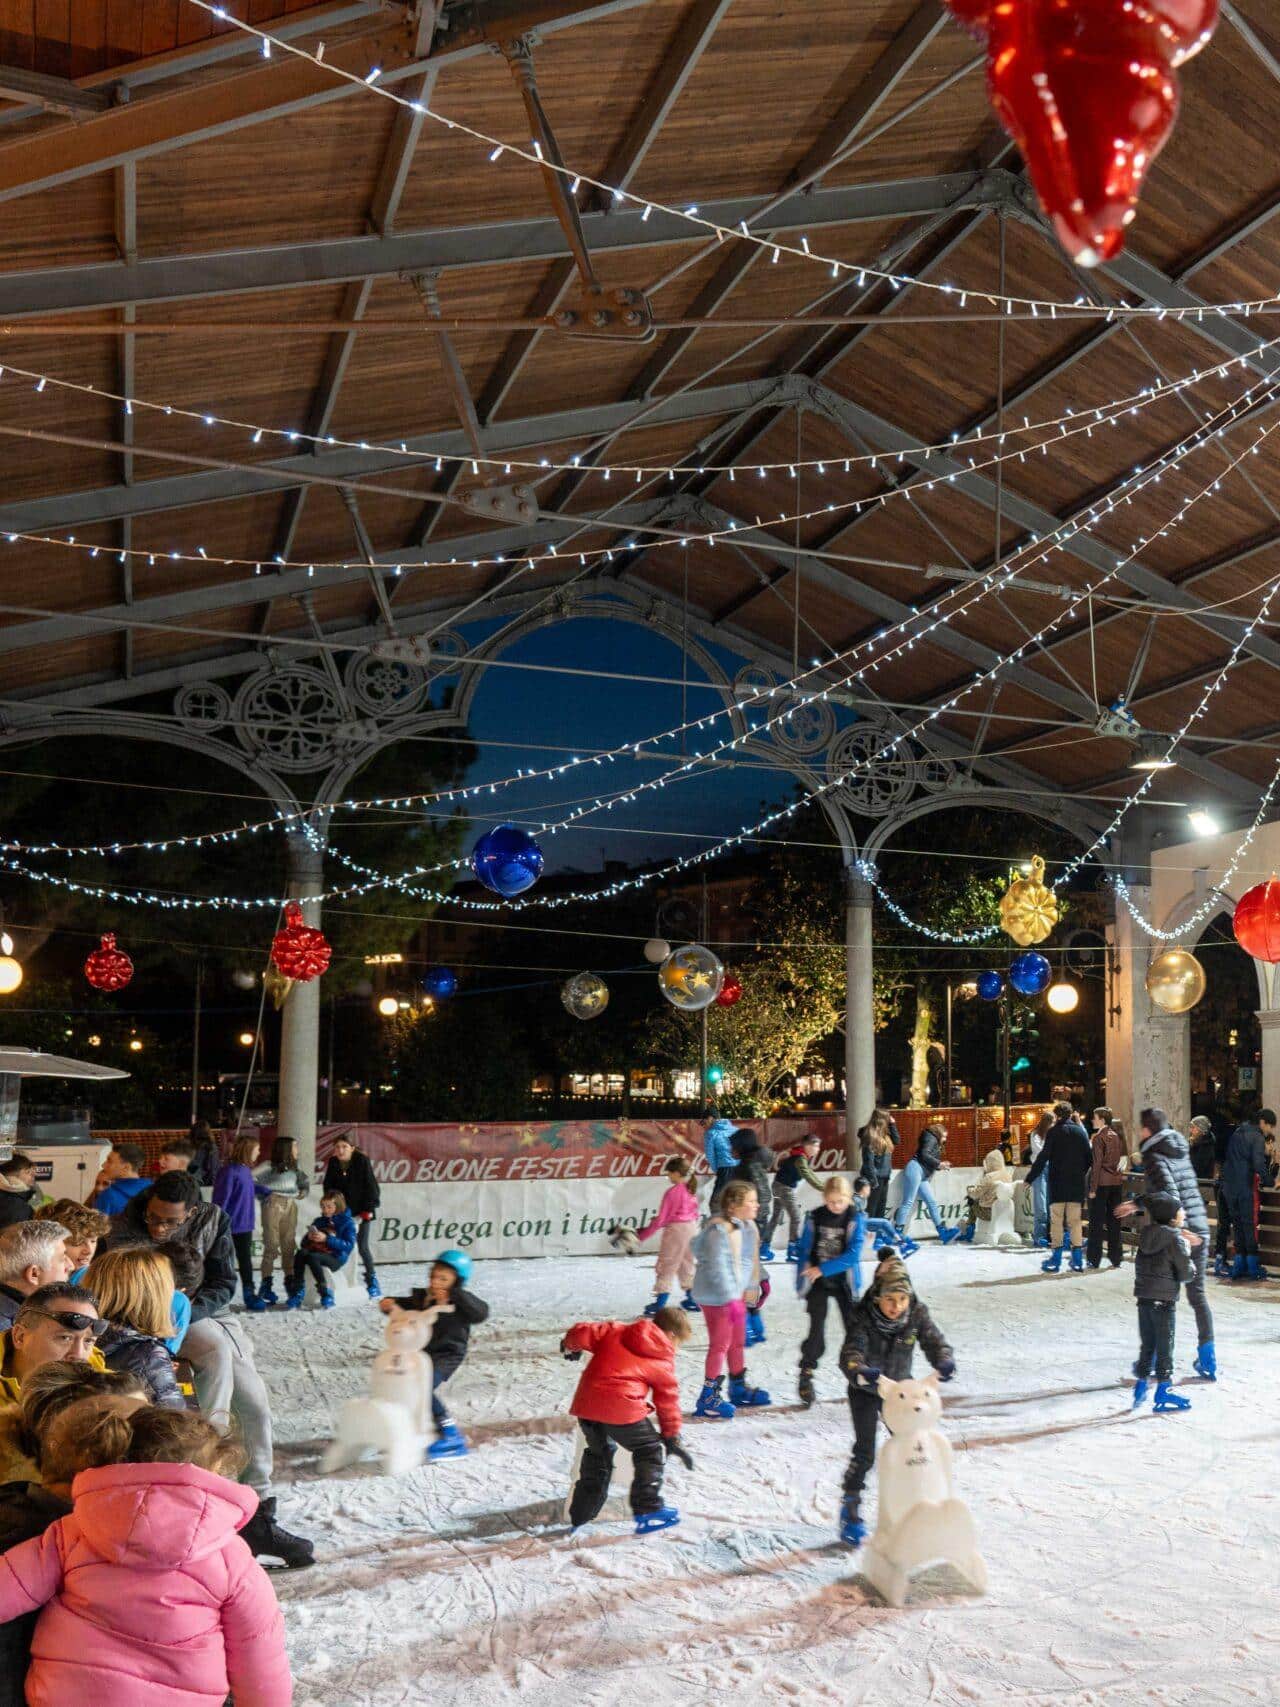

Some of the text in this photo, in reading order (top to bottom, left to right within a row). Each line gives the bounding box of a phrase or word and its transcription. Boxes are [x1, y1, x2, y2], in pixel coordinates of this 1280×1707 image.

[415, 1157, 504, 1182] BUONE
[506, 1154, 584, 1180] FESTE
[586, 1155, 606, 1177] E
[609, 1154, 644, 1176] UN
[378, 1217, 494, 1246] Bottega
[502, 1218, 552, 1238] con
[561, 1213, 571, 1235] i
